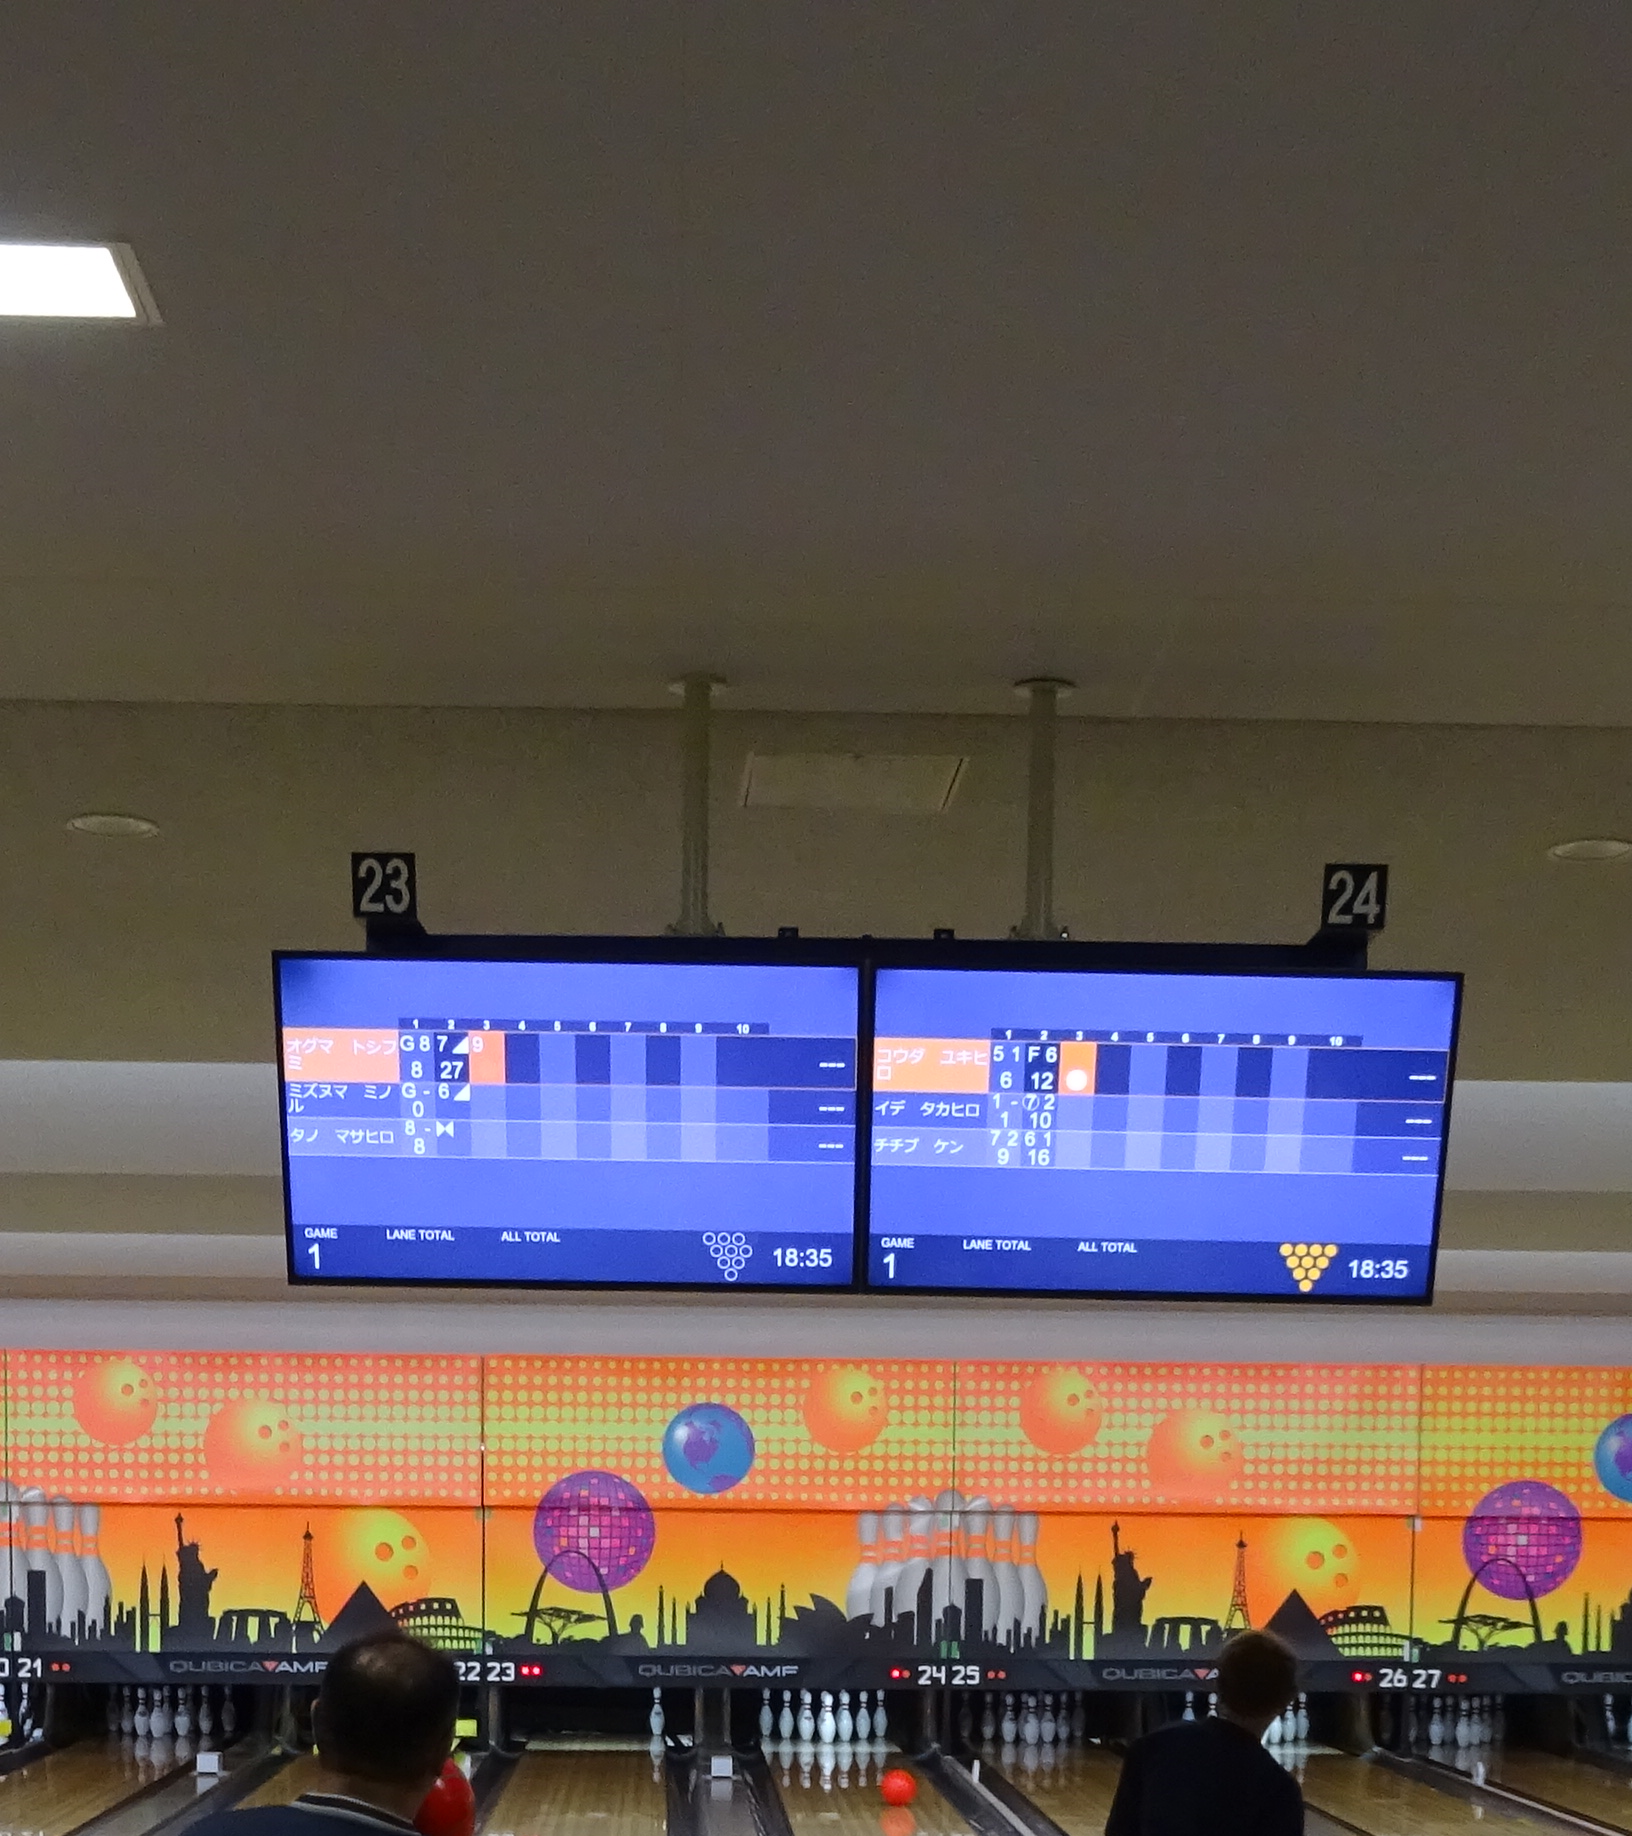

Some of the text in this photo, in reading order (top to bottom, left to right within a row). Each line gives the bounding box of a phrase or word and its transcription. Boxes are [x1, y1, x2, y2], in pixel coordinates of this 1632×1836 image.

[358, 858, 411, 914] 23
[1328, 870, 1381, 924] 24
[286, 1037, 397, 1055] オグマ トシフ
[472, 1036, 484, 1053] 9
[288, 1054, 302, 1070] ミ
[877, 1048, 988, 1066] コウダ ユキヒ
[411, 1061, 464, 1079] 8 27
[1000, 1071, 1054, 1090] 6 12
[289, 1082, 392, 1099] ミズヌマ ミノ
[438, 1082, 450, 1099] 6
[287, 1098, 305, 1113] ル
[412, 1101, 424, 1117] 0
[875, 1100, 980, 1117] イデ タカヒロ
[1030, 1112, 1052, 1129] 10
[290, 1127, 394, 1144] タノ マサヒロ
[413, 1138, 426, 1155] 8
[874, 1138, 964, 1154] チチブ ケン
[997, 1148, 1050, 1166] 9 16
[304, 1227, 561, 1243] GAME LANE TOTAL ALL TOTAL
[881, 1237, 1137, 1253] GAME LANE TOTAL ALL TOTAL
[308, 1243, 833, 1270] 1 18:35
[882, 1252, 1409, 1279] 1 18:35
[17, 1657, 43, 1679] 21
[454, 1661, 516, 1682] 22 23
[918, 1665, 981, 1686] 24 25
[1378, 1668, 1442, 1690] 26 27
